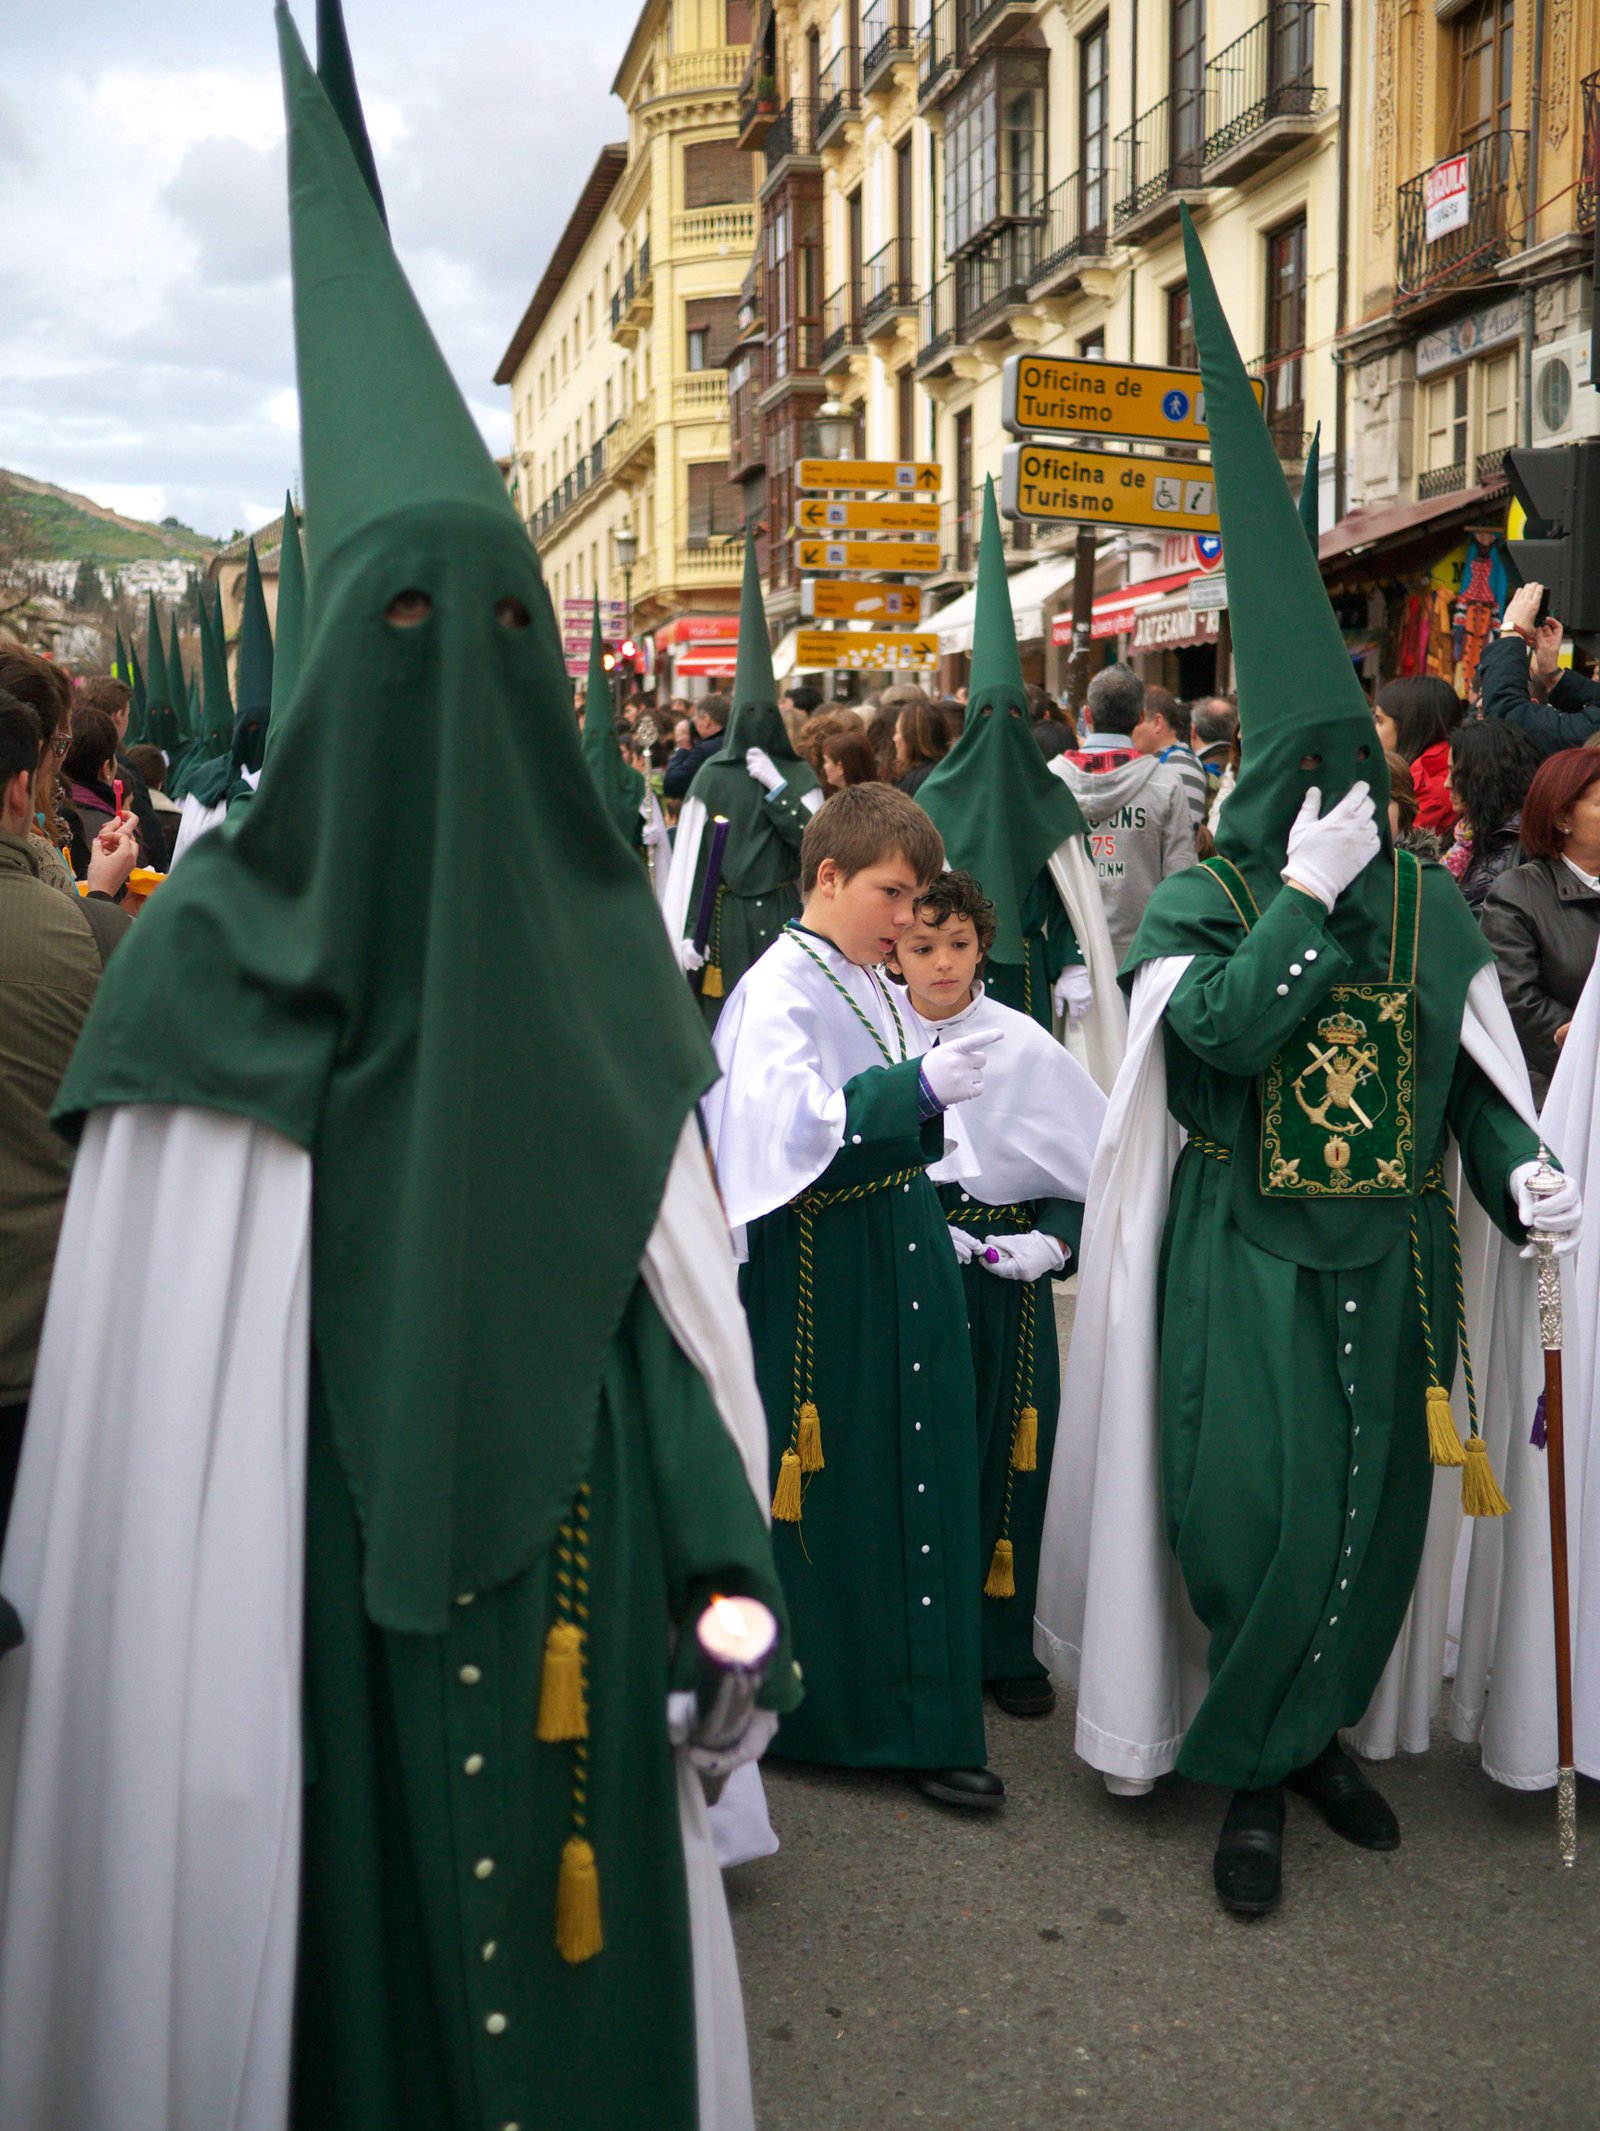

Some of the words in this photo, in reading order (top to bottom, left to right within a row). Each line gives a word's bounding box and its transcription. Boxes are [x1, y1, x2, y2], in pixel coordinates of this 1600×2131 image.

[1024, 366, 1105, 395] Oficina
[1116, 377, 1142, 398] de
[1023, 395, 1113, 422] Turismo
[1024, 456, 1105, 484] Oficina
[1121, 468, 1146, 488] de
[1023, 484, 1114, 512] Turismo
[1092, 836, 1115, 857] 75
